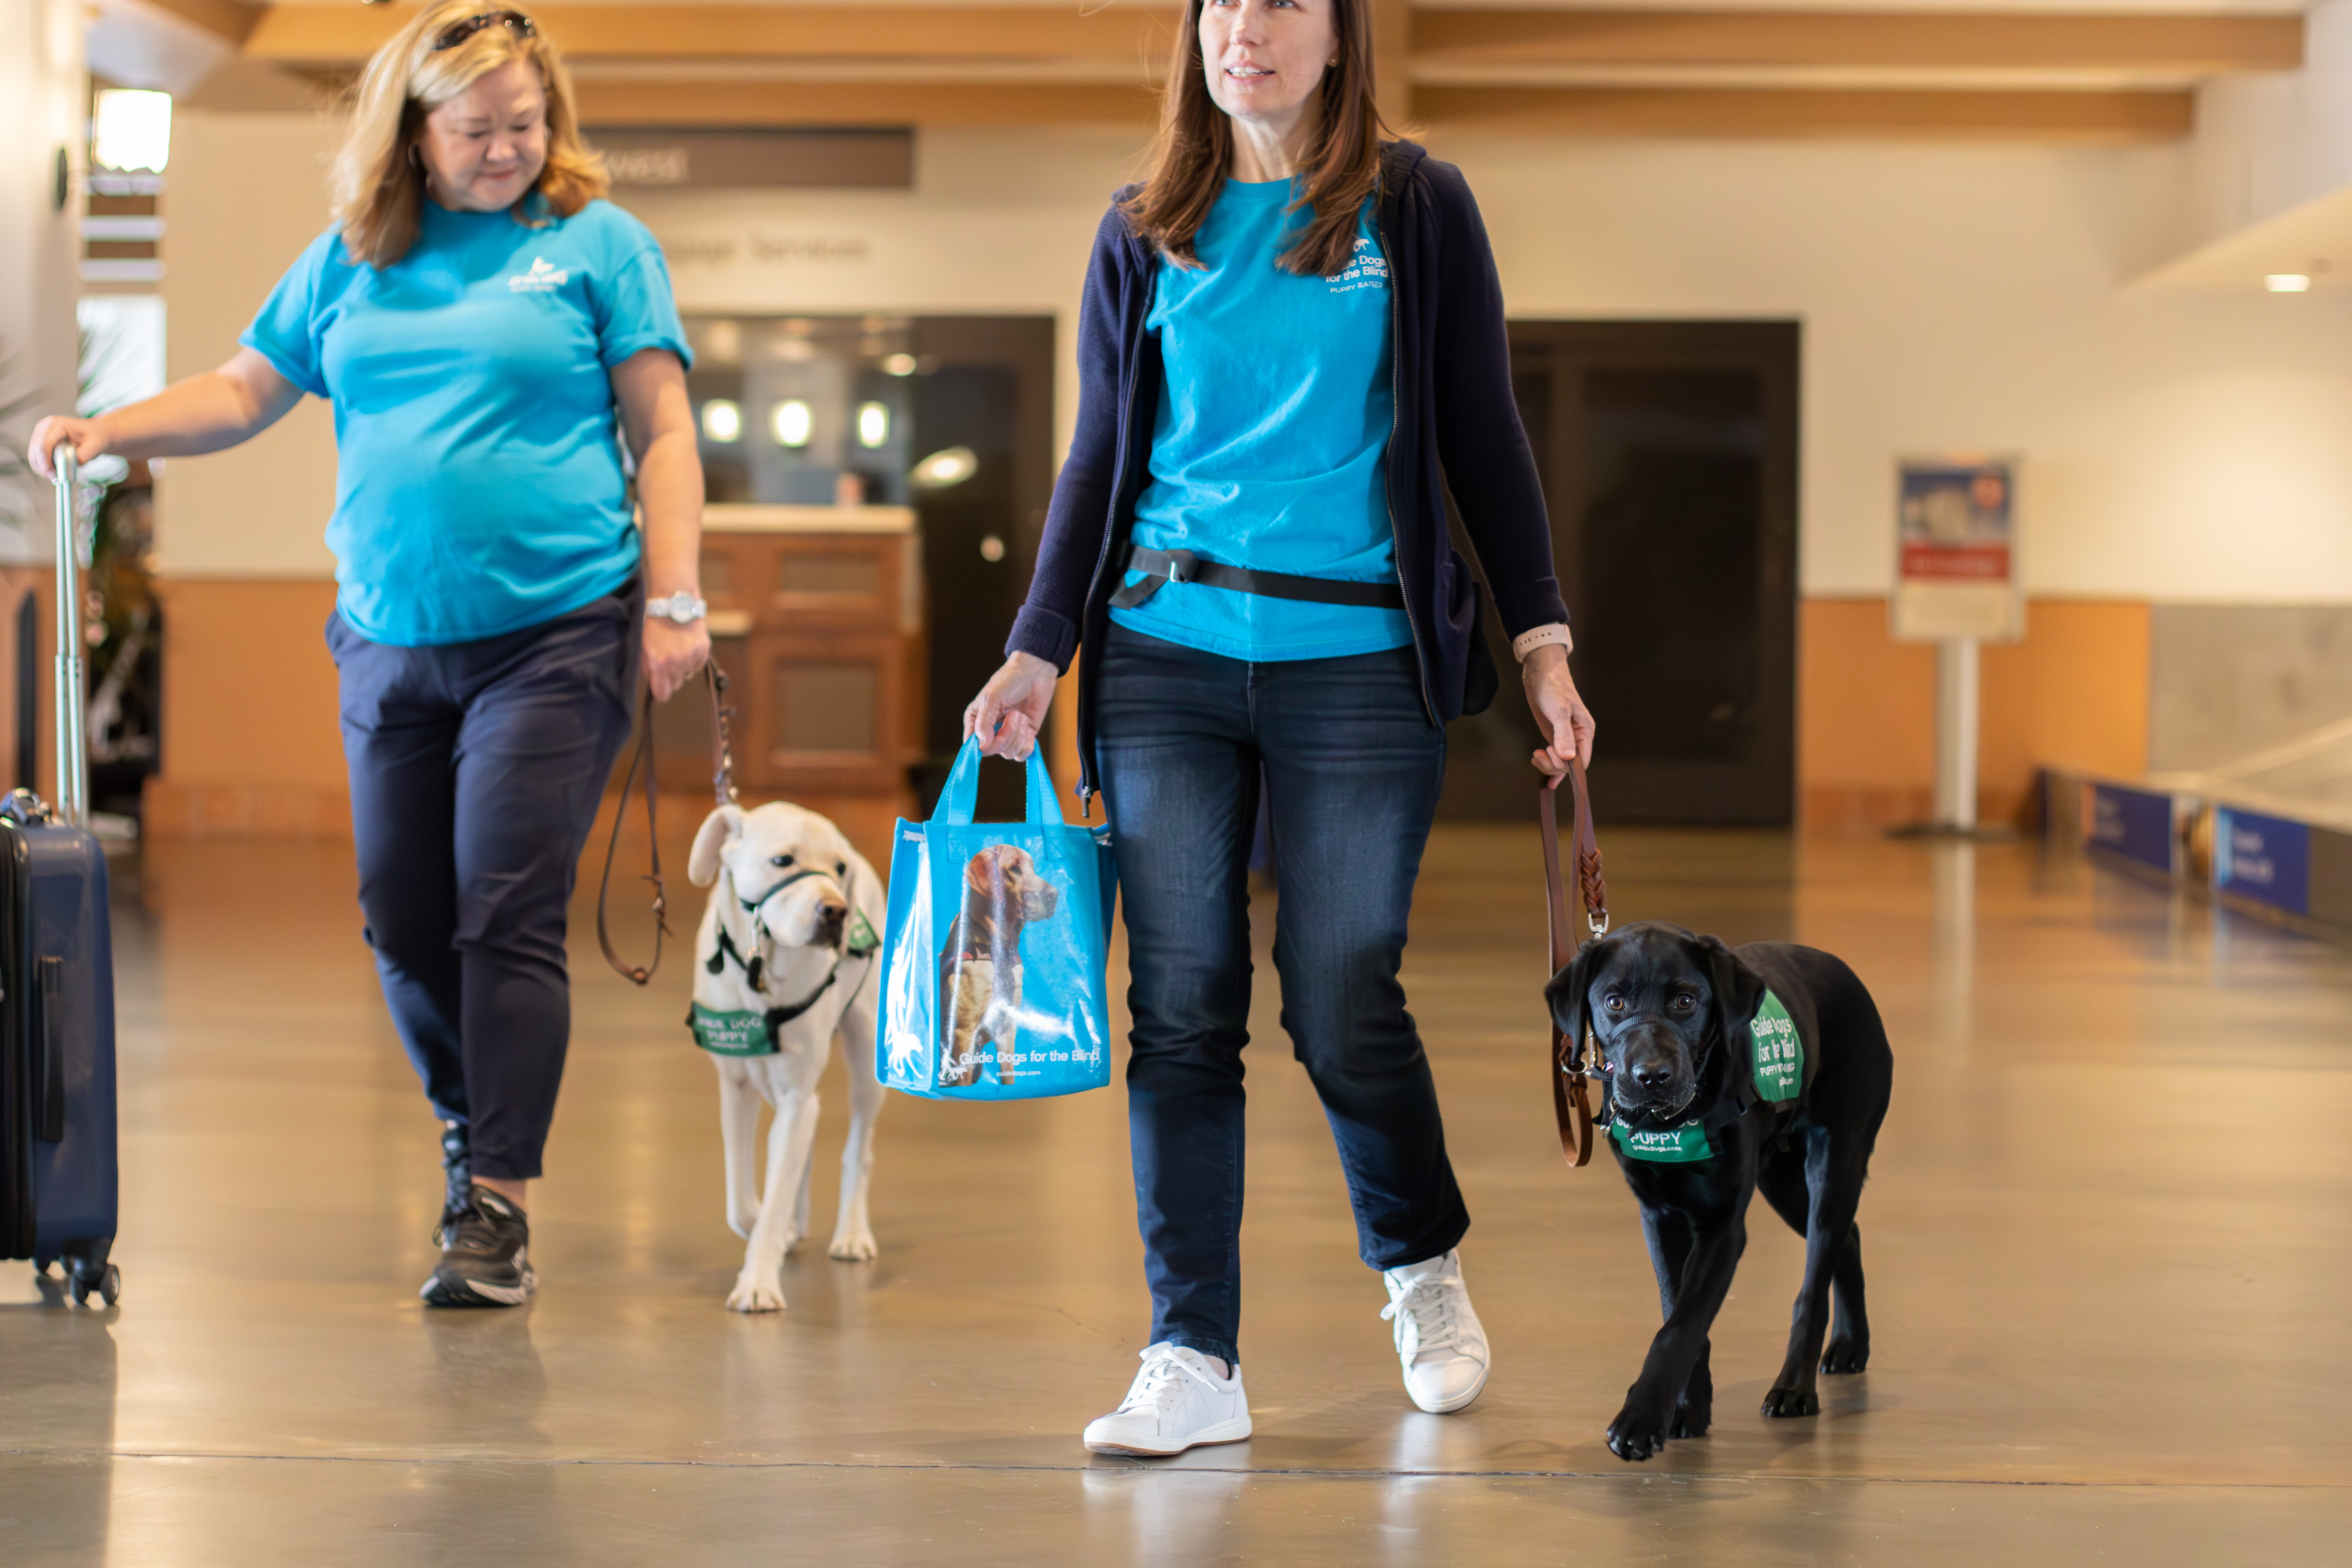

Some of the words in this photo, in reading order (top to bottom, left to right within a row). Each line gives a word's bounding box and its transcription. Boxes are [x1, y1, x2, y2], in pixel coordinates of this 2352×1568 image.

[1359, 255, 1387, 267] Dogs
[1343, 269, 1360, 281] the
[1363, 266, 1388, 278] Blind
[1330, 285, 1356, 293] PUPPY
[1750, 1015, 1773, 1038] Guide
[959, 1051, 994, 1065] Guide
[997, 1051, 1028, 1065] Dogs
[1029, 1050, 1047, 1062] for
[1049, 1049, 1069, 1062] the
[1072, 1049, 1101, 1062] Blind
[1759, 1042, 1770, 1062] for
[1630, 1131, 1681, 1145] PUPPY
